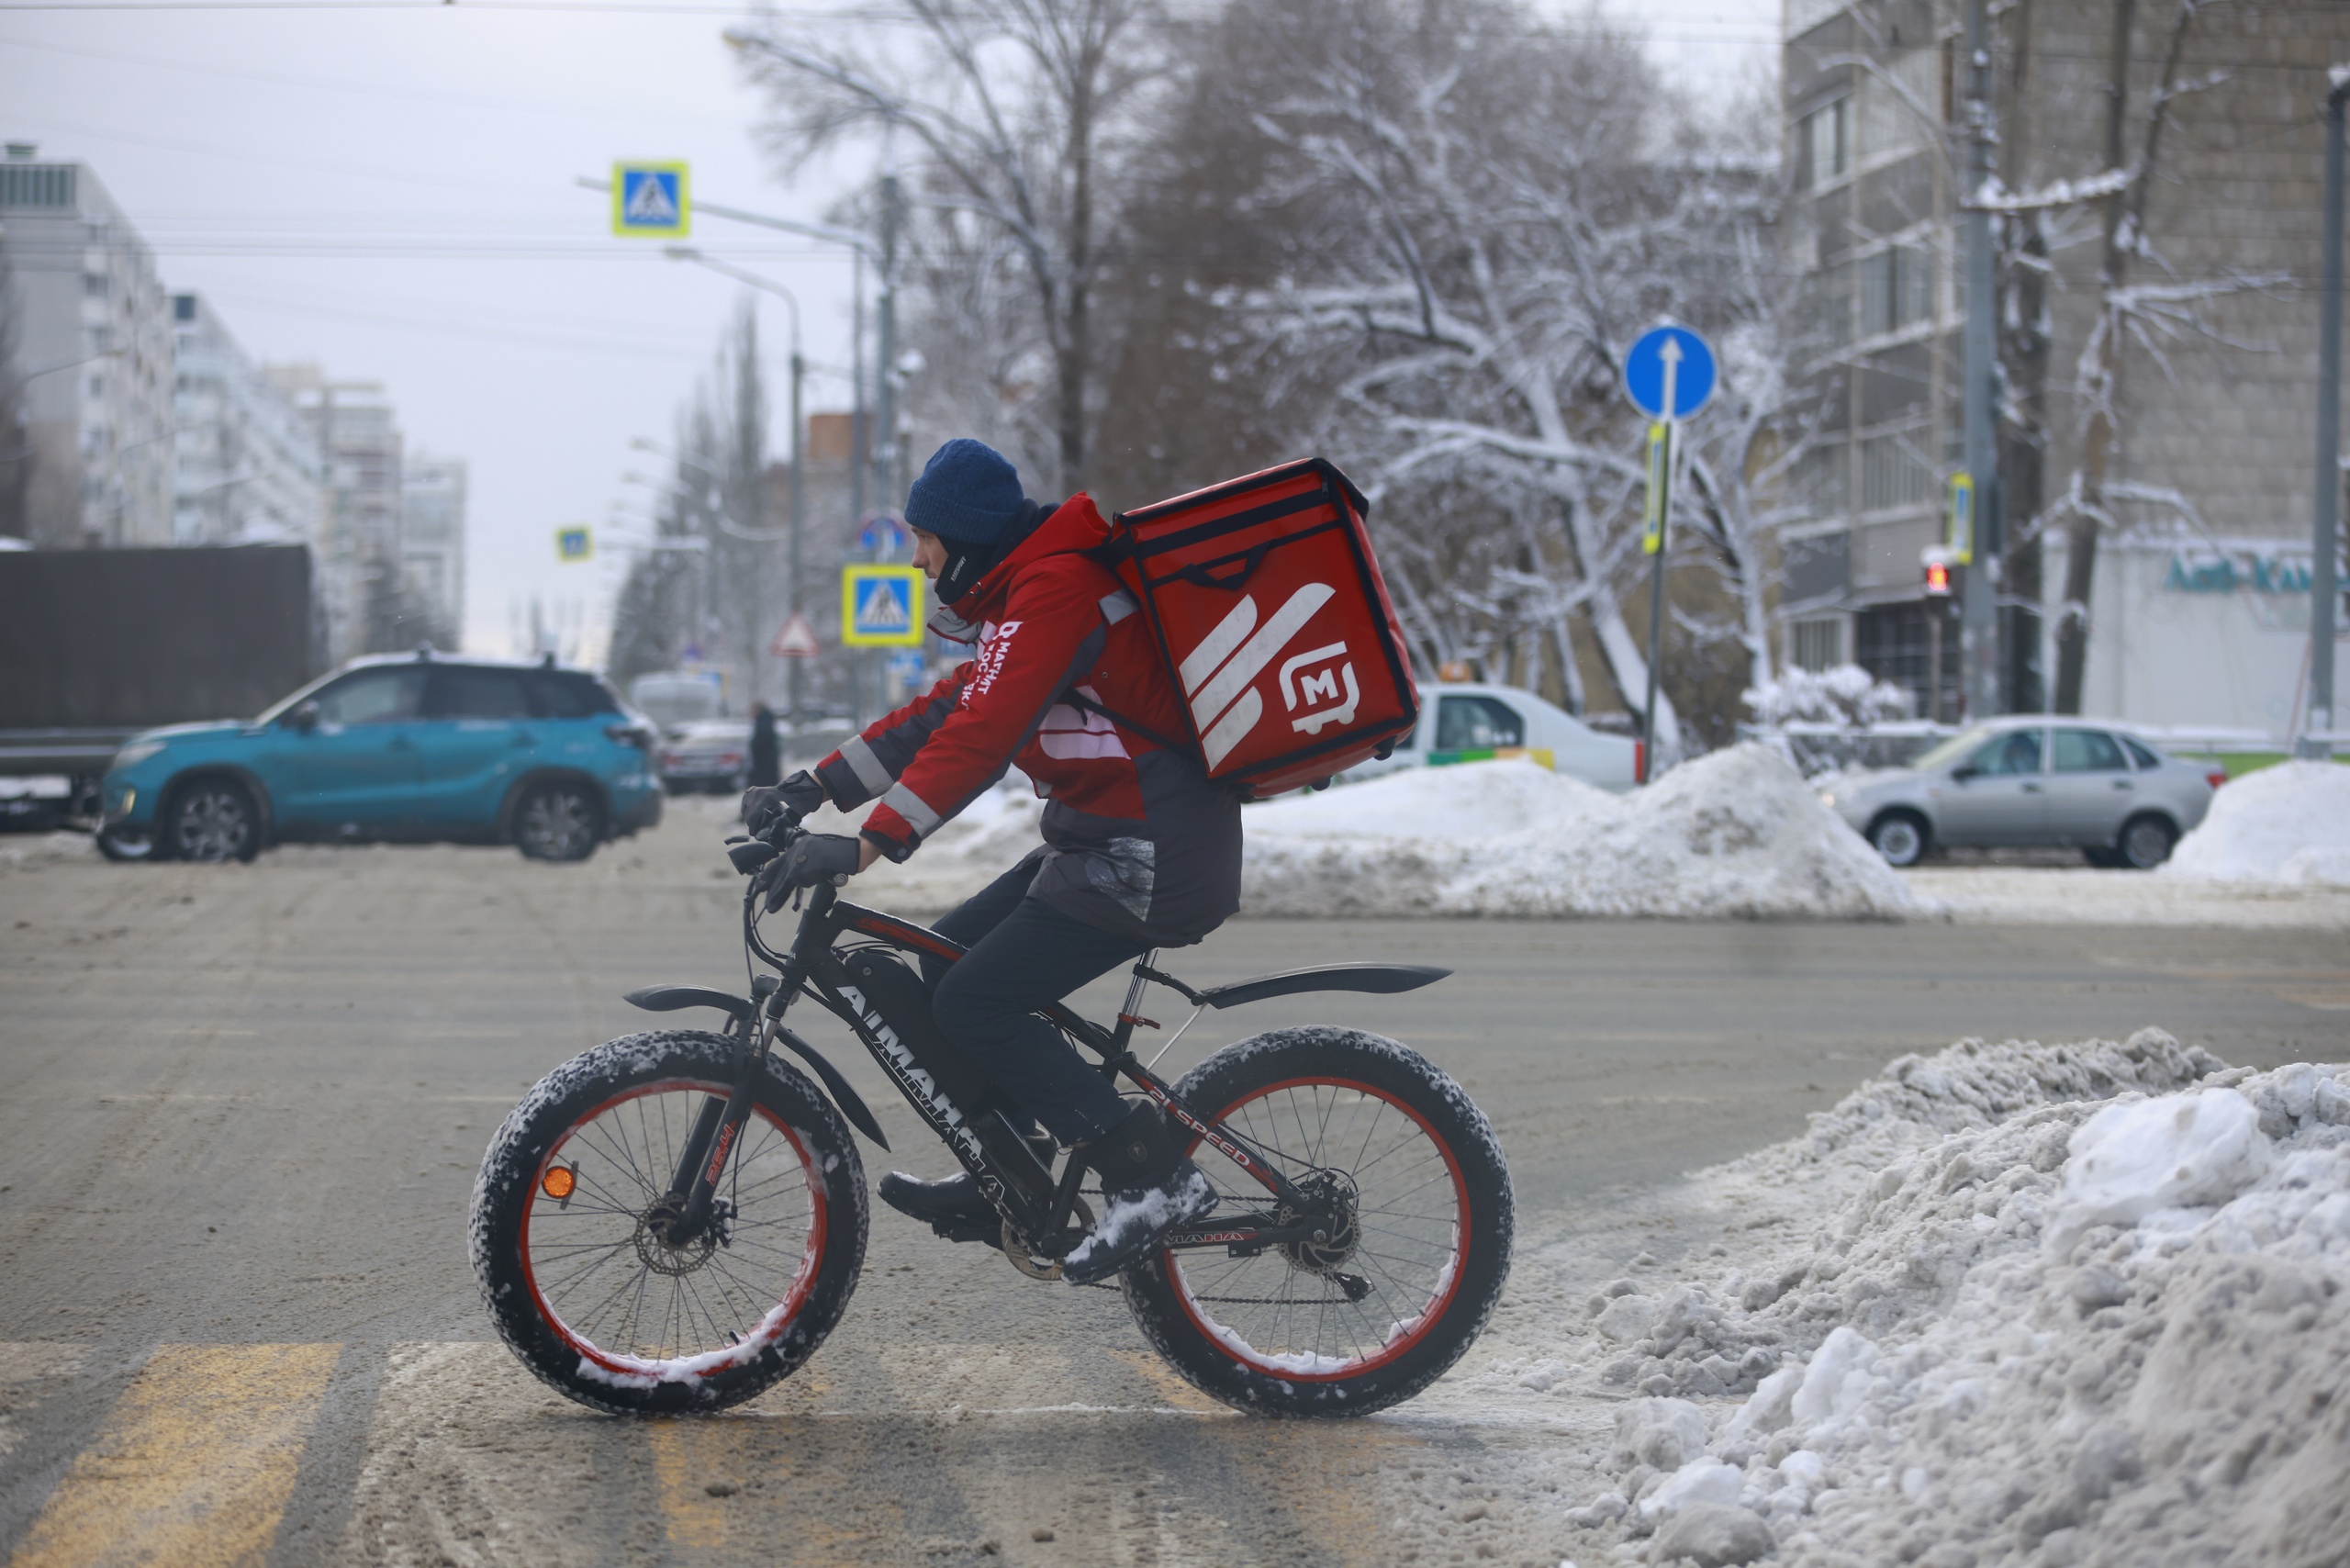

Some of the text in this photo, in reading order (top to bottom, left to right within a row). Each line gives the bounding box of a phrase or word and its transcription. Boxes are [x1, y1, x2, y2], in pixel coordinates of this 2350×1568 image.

[978, 642, 1011, 695] МАГНИТ
[836, 986, 983, 1157] AIMAHA
[705, 1125, 735, 1185] 26.4
[1149, 1086, 1249, 1166] 21 SPEED
